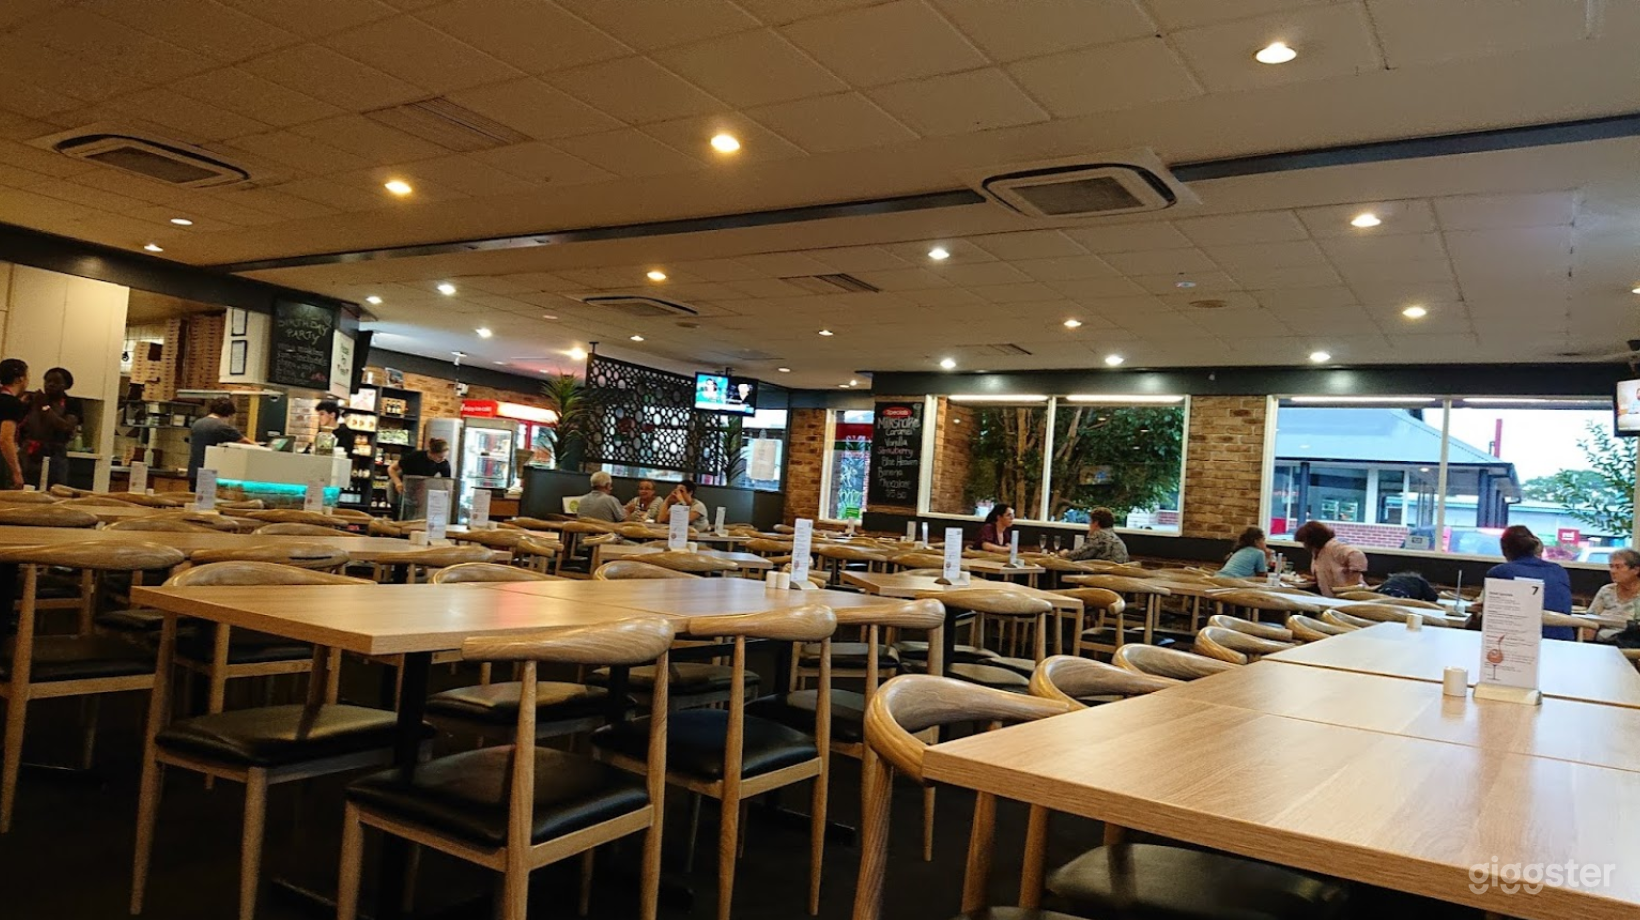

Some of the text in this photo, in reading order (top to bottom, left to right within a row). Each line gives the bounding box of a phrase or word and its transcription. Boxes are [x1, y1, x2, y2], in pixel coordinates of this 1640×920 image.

[285, 327, 320, 345] PARTY
[884, 436, 908, 447] Vanilla
[1531, 585, 1539, 596] 7
